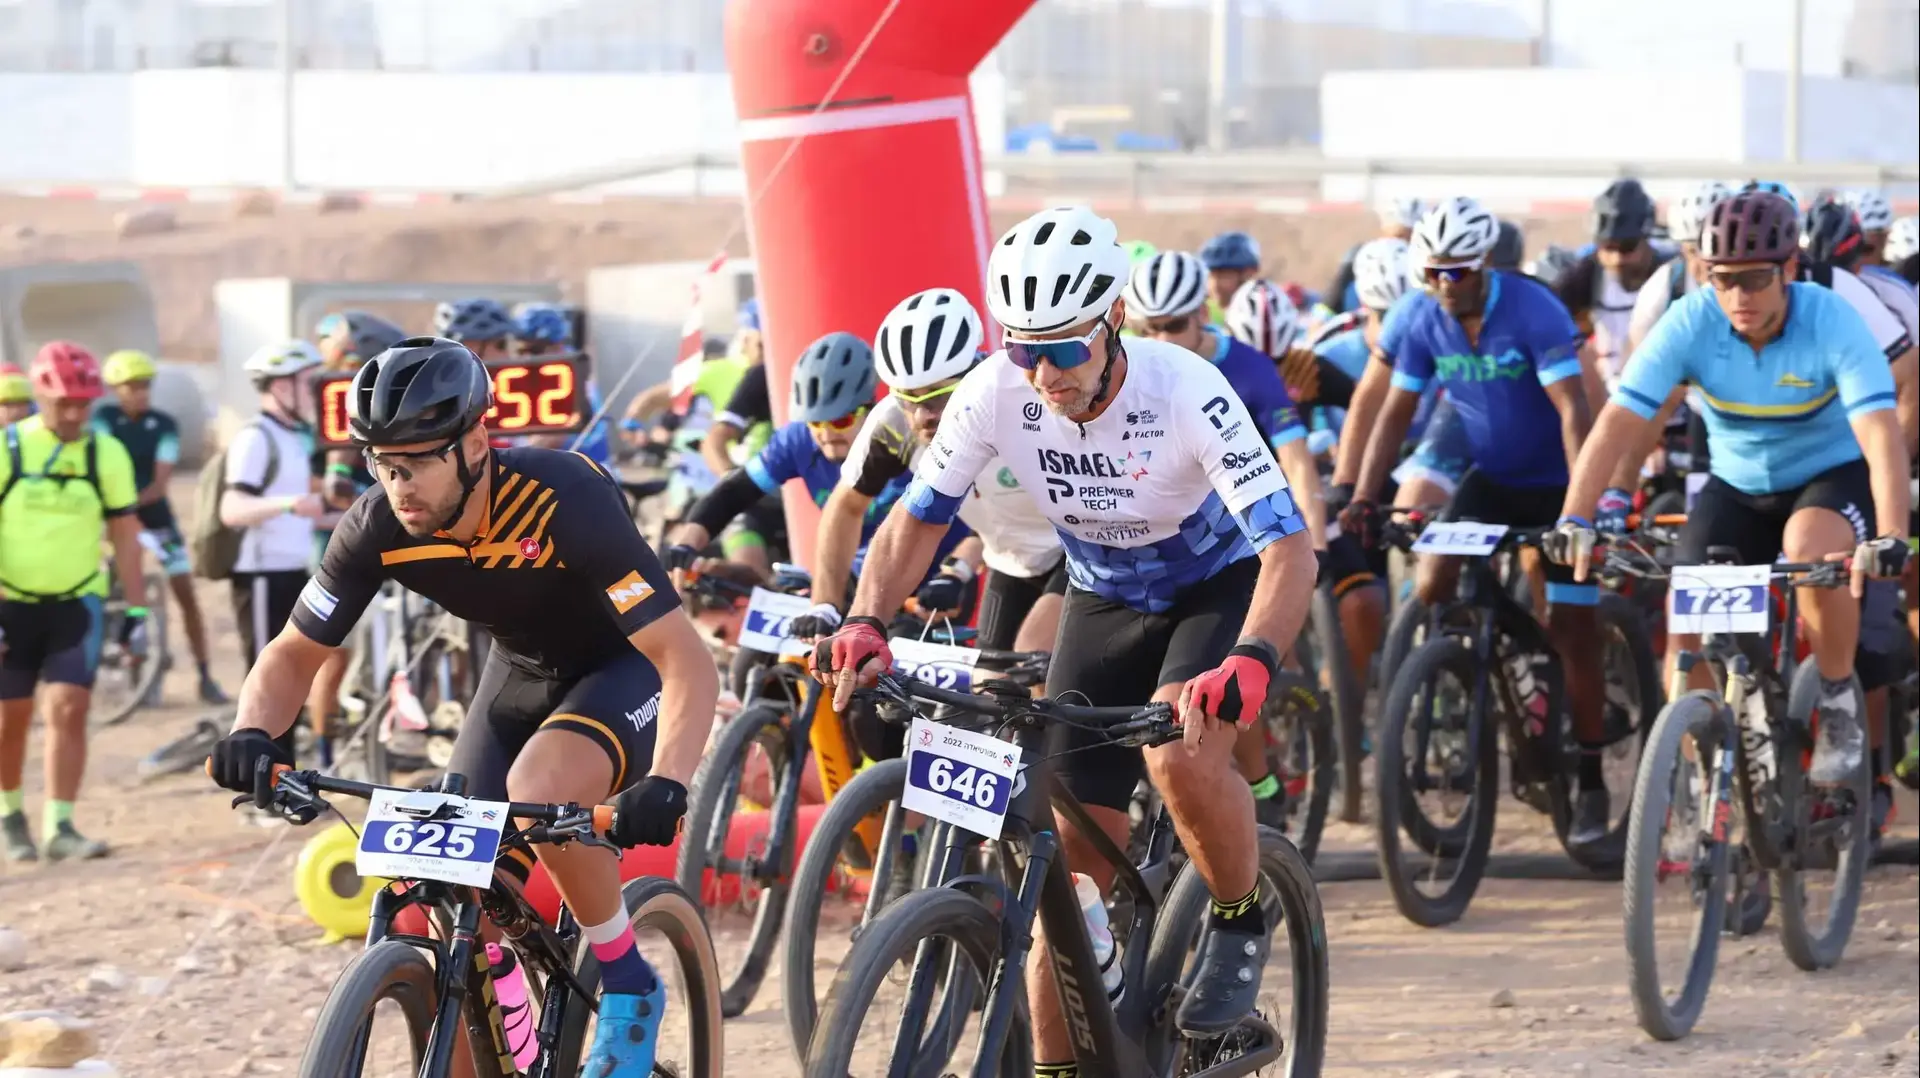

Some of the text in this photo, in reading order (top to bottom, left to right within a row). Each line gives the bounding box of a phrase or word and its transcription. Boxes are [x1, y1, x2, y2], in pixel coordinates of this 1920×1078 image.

[1134, 429, 1165, 439] FACTOR
[1220, 420, 1243, 439] PREMIER
[1223, 429, 1240, 443] TECH
[1038, 448, 1122, 478] ISRAEL
[1233, 462, 1272, 489] MAXXIS
[1079, 485, 1136, 499] PREMIER
[1081, 498, 1118, 511] TECH
[1686, 586, 1753, 614] 722
[943, 736, 963, 748] 2022
[928, 757, 998, 808] 646
[383, 822, 478, 859] 625
[1052, 944, 1098, 1056] SCOTT
